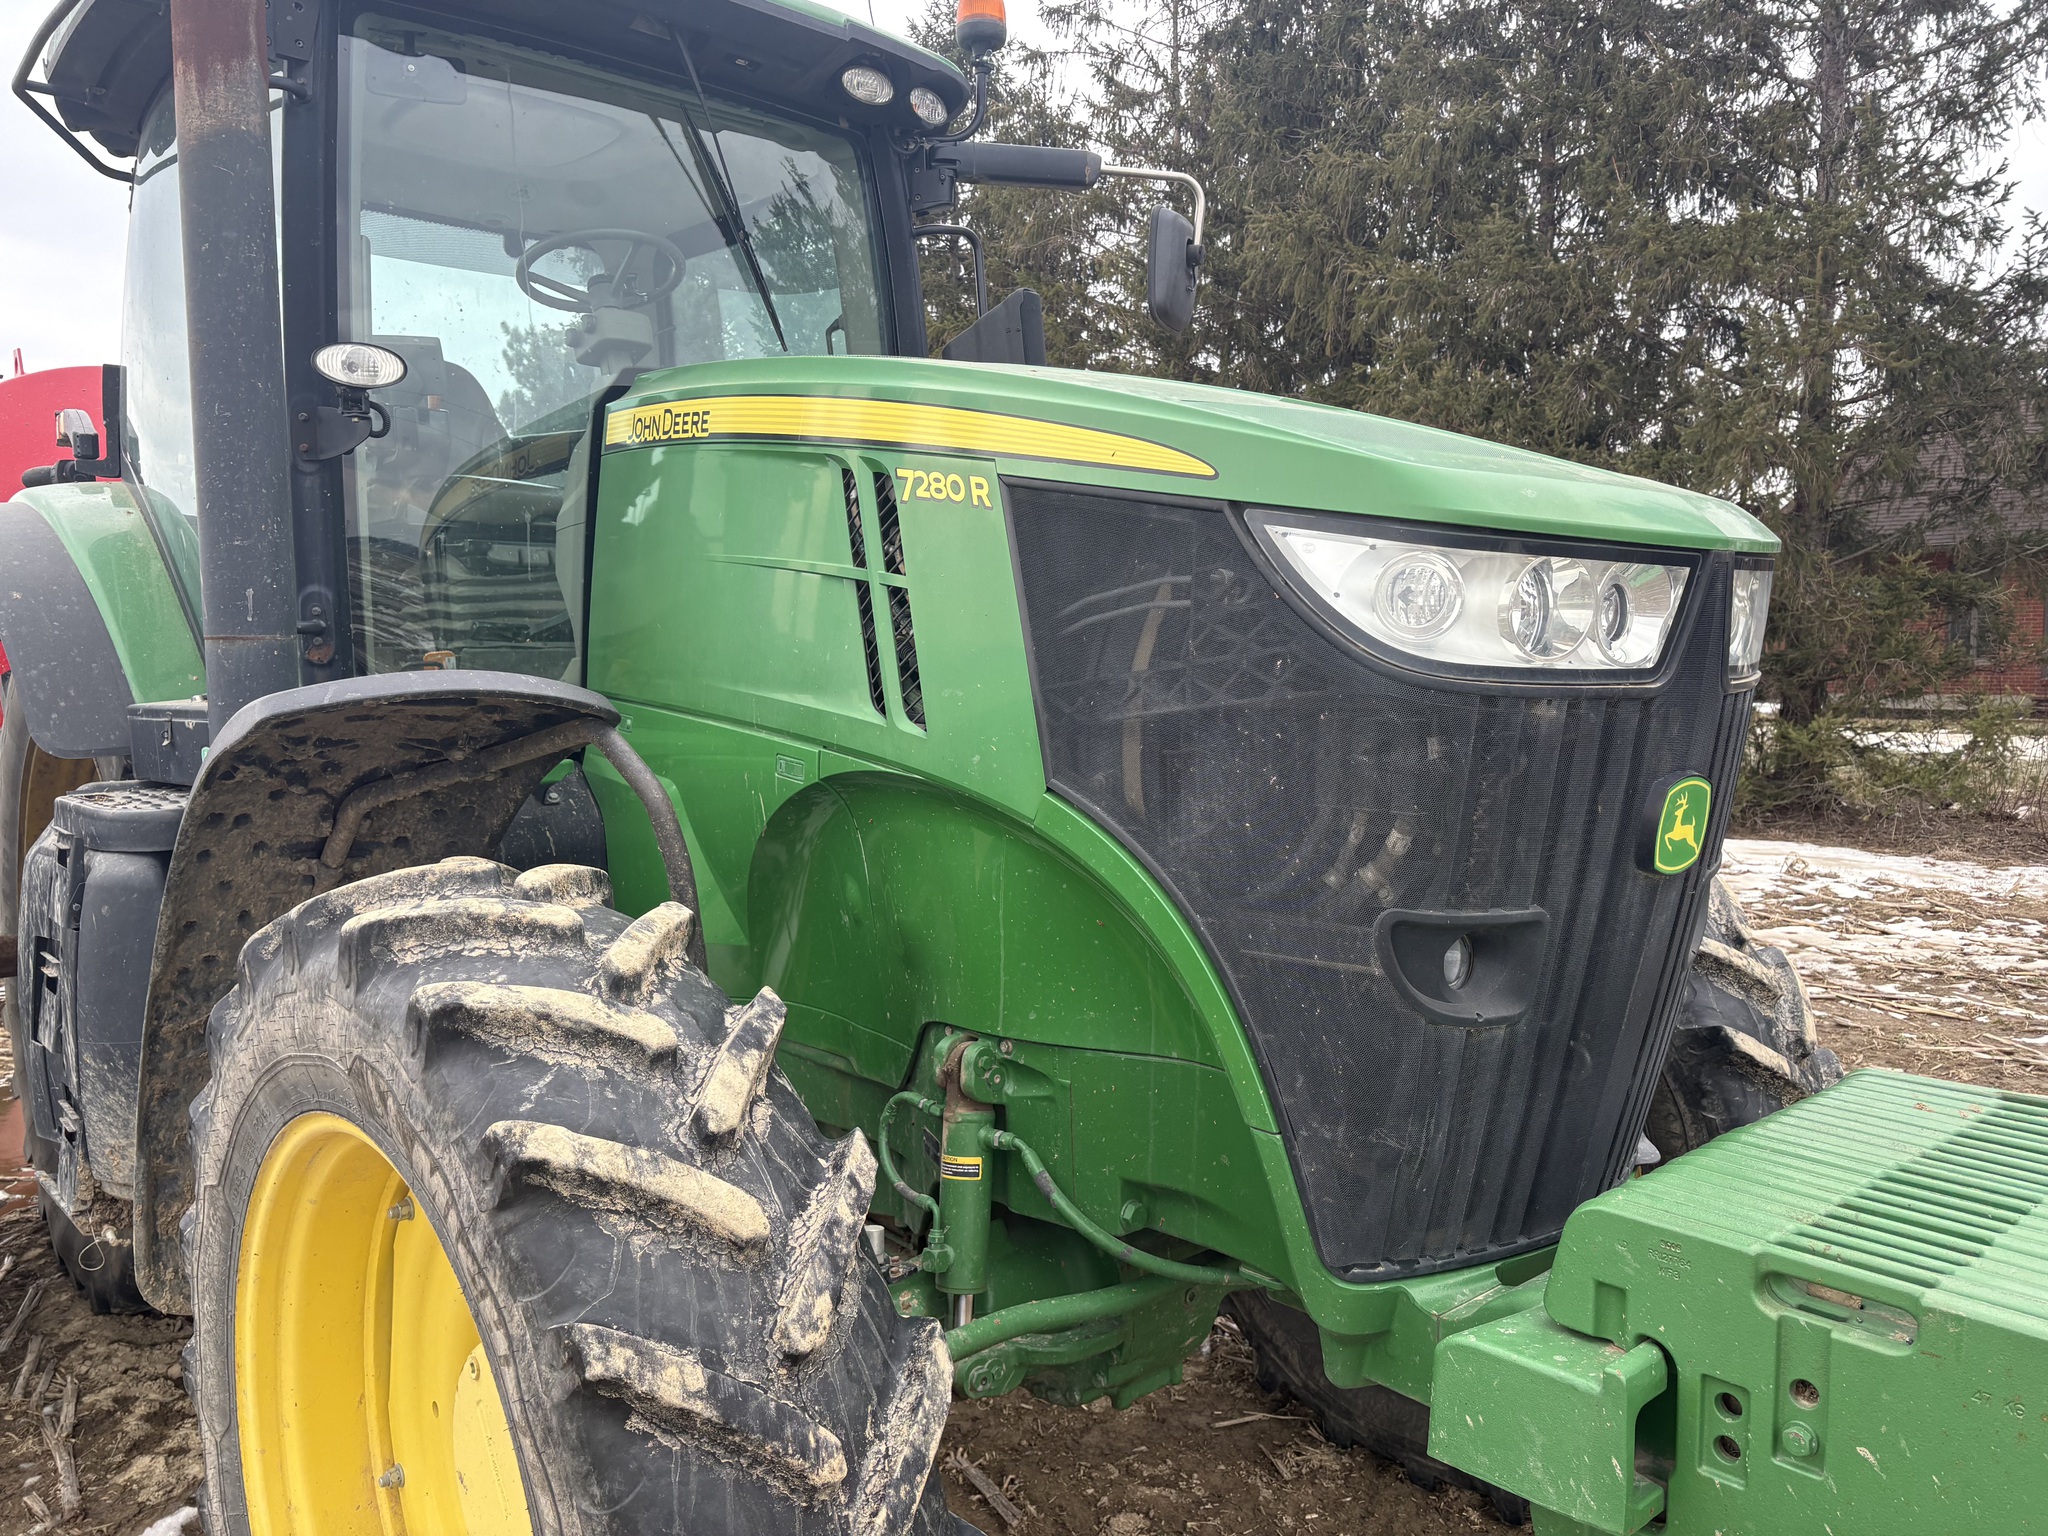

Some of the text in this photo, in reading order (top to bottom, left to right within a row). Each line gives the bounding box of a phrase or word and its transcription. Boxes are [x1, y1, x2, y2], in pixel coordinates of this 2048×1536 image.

[662, 408, 711, 437] DEERE
[895, 467, 993, 510] 7280 R
[1970, 1389, 1993, 1407] 47
